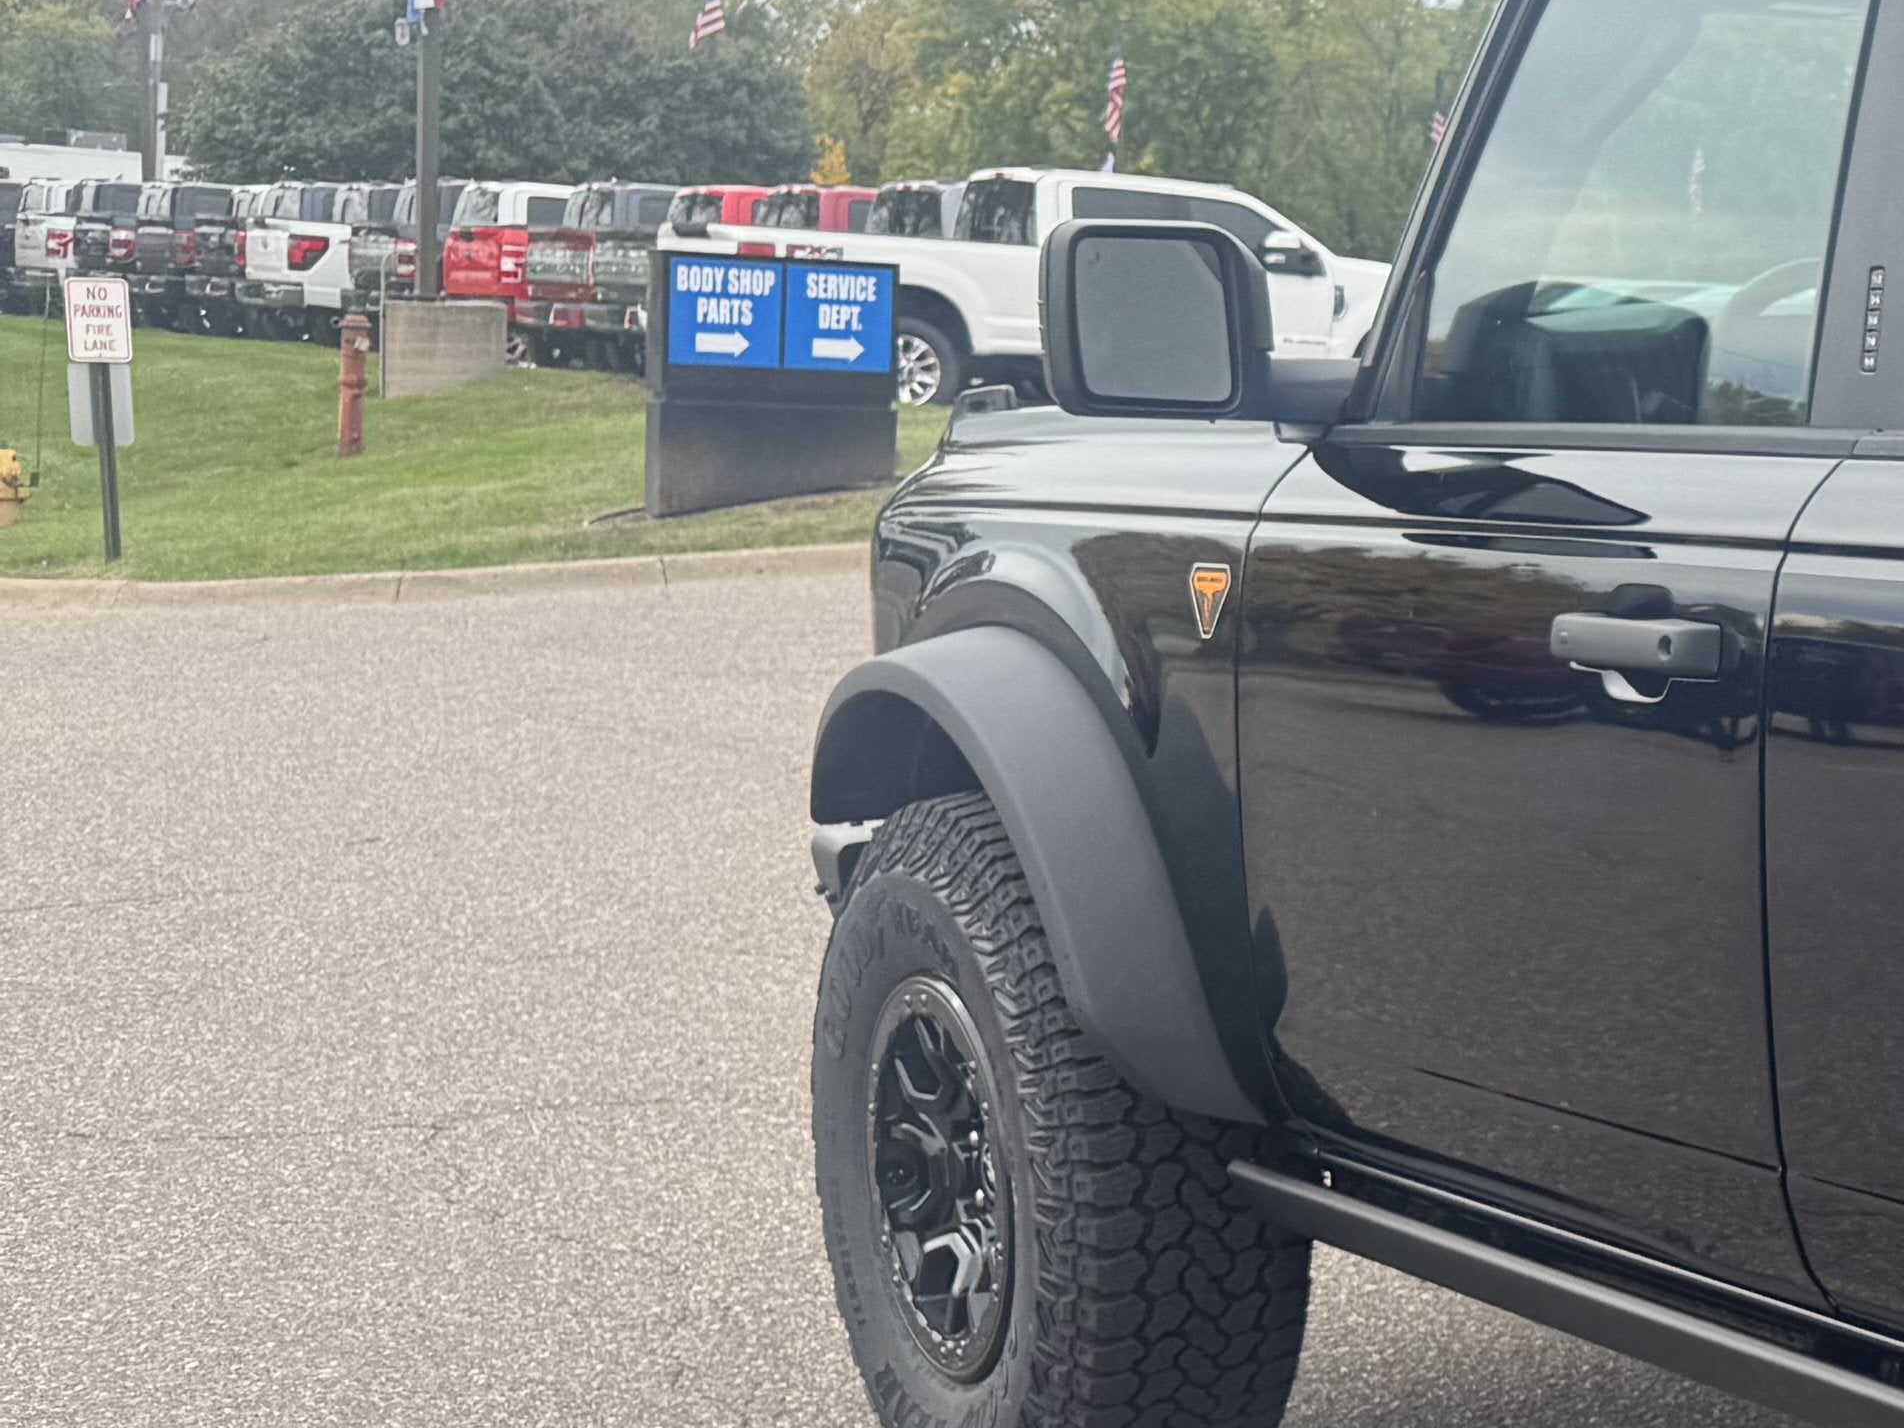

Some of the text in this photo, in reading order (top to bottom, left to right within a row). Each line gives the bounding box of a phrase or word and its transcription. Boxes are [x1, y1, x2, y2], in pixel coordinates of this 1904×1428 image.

[676, 264, 776, 297] BODY SHOP
[806, 272, 877, 302] SERVICE
[86, 285, 108, 301] NO
[73, 303, 123, 319] PARKING
[696, 297, 753, 326] PARTS
[818, 303, 863, 331] DEPT.
[85, 323, 113, 337] FIRE
[84, 339, 117, 352] LANE
